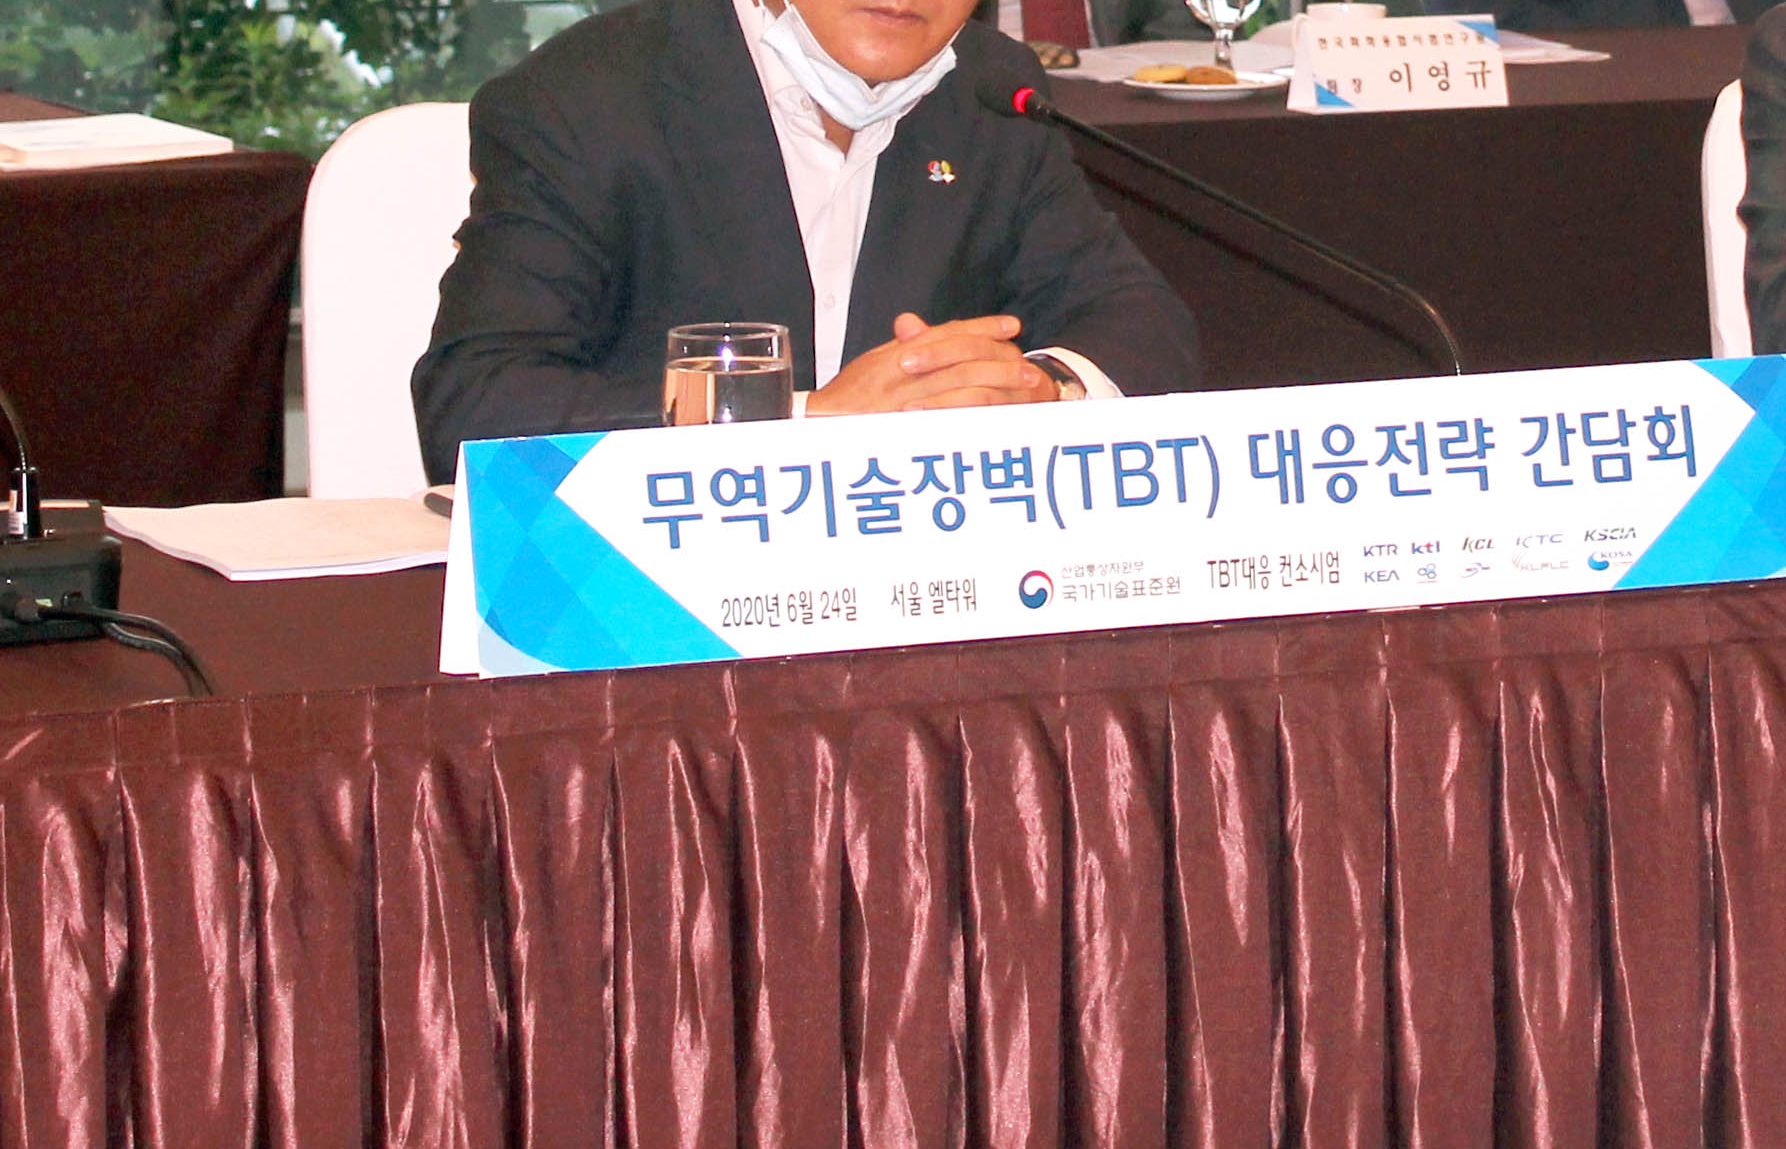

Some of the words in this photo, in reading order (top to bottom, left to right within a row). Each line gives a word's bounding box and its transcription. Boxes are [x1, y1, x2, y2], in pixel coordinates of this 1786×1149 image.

[1247, 418, 1496, 506] 대응전략
[1519, 404, 1699, 489] 간담회
[1363, 543, 1398, 558] KTR
[1461, 537, 1496, 553] KCL
[1061, 561, 1145, 578] 산업통상자원부
[1206, 554, 1273, 590] TBT대응
[1279, 550, 1340, 587] 컨소시엄
[1363, 569, 1400, 584] KEA
[1062, 576, 1182, 602] 국가기술표준원
[721, 595, 781, 628] 2020년
[787, 590, 814, 625] 6월
[820, 587, 857, 622] 24일
[890, 581, 923, 617] 서울
[928, 577, 977, 614] 엘타워
